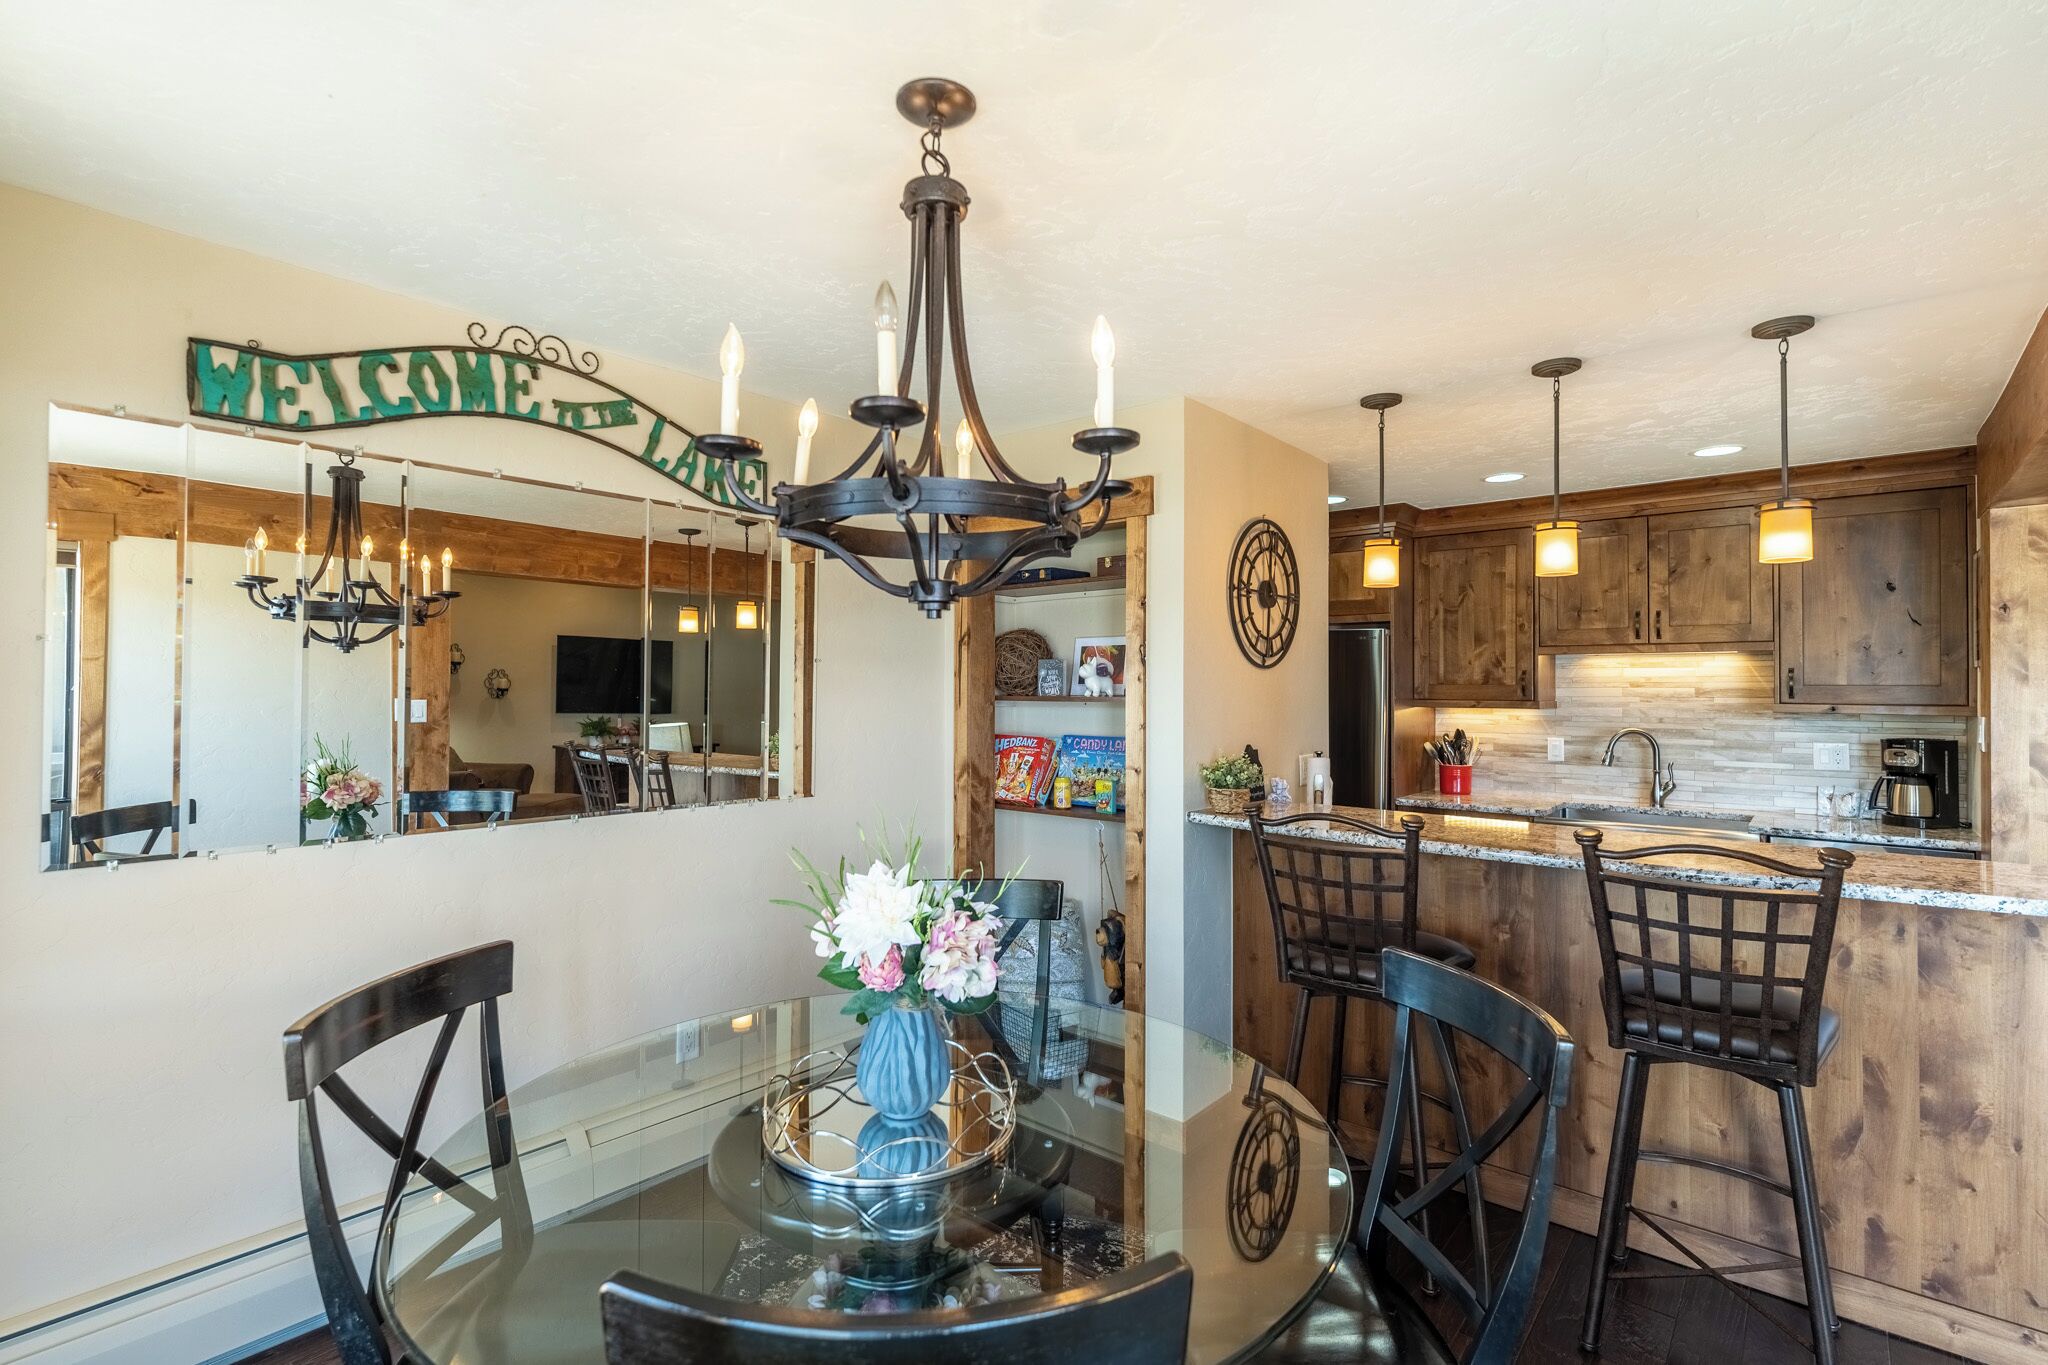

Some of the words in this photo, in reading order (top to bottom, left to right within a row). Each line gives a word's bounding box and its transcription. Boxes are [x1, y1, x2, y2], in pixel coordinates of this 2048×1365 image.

[196, 342, 540, 426] WELCOME
[552, 399, 584, 429] TO
[592, 399, 637, 426] THE
[642, 416, 762, 508] LAKE
[995, 736, 1038, 753] HEDBANZ
[1073, 738, 1107, 750] CANDY
